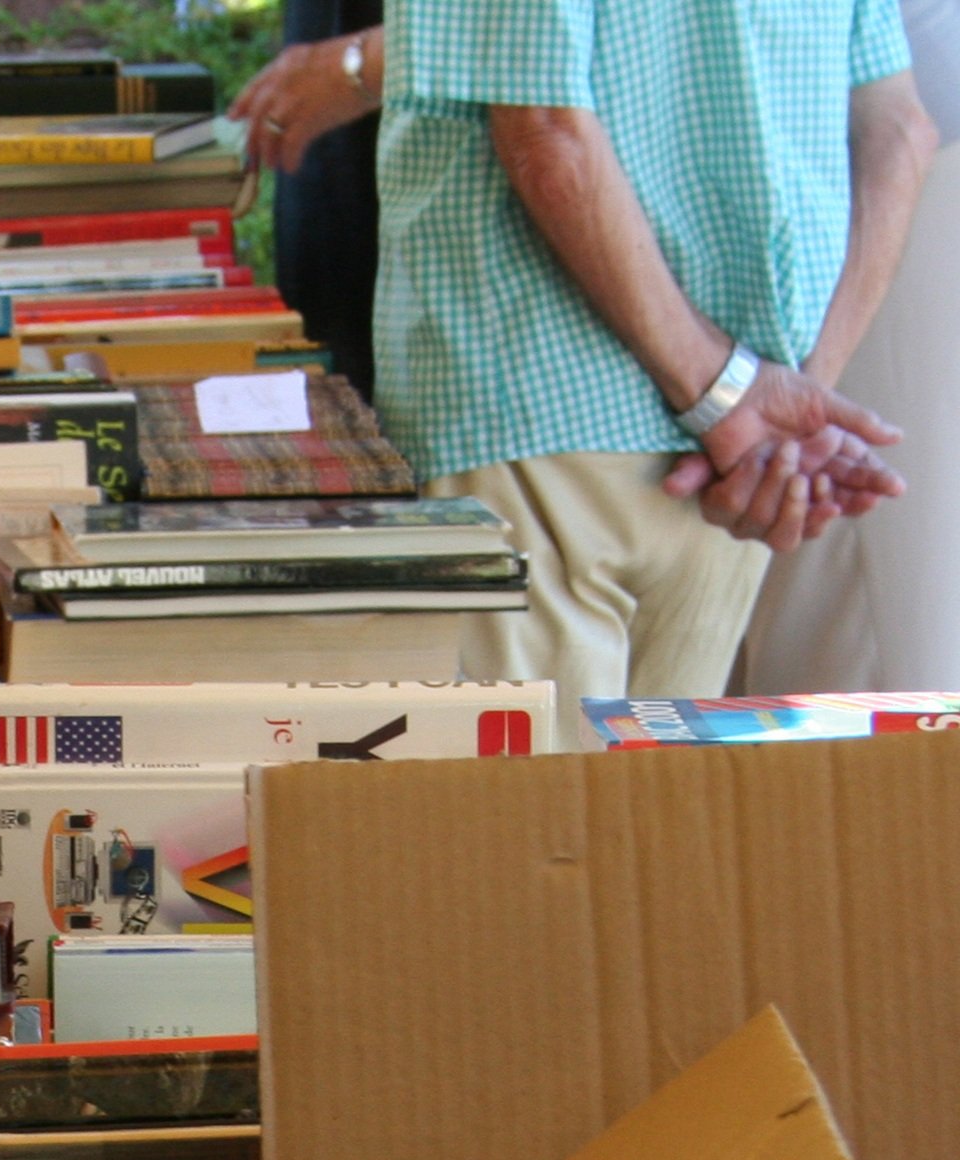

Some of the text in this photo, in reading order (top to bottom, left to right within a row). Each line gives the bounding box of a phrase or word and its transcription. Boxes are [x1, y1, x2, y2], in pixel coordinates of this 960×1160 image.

[95, 419, 126, 451] Le
[40, 563, 205, 588] NOUVEL ATLAS
